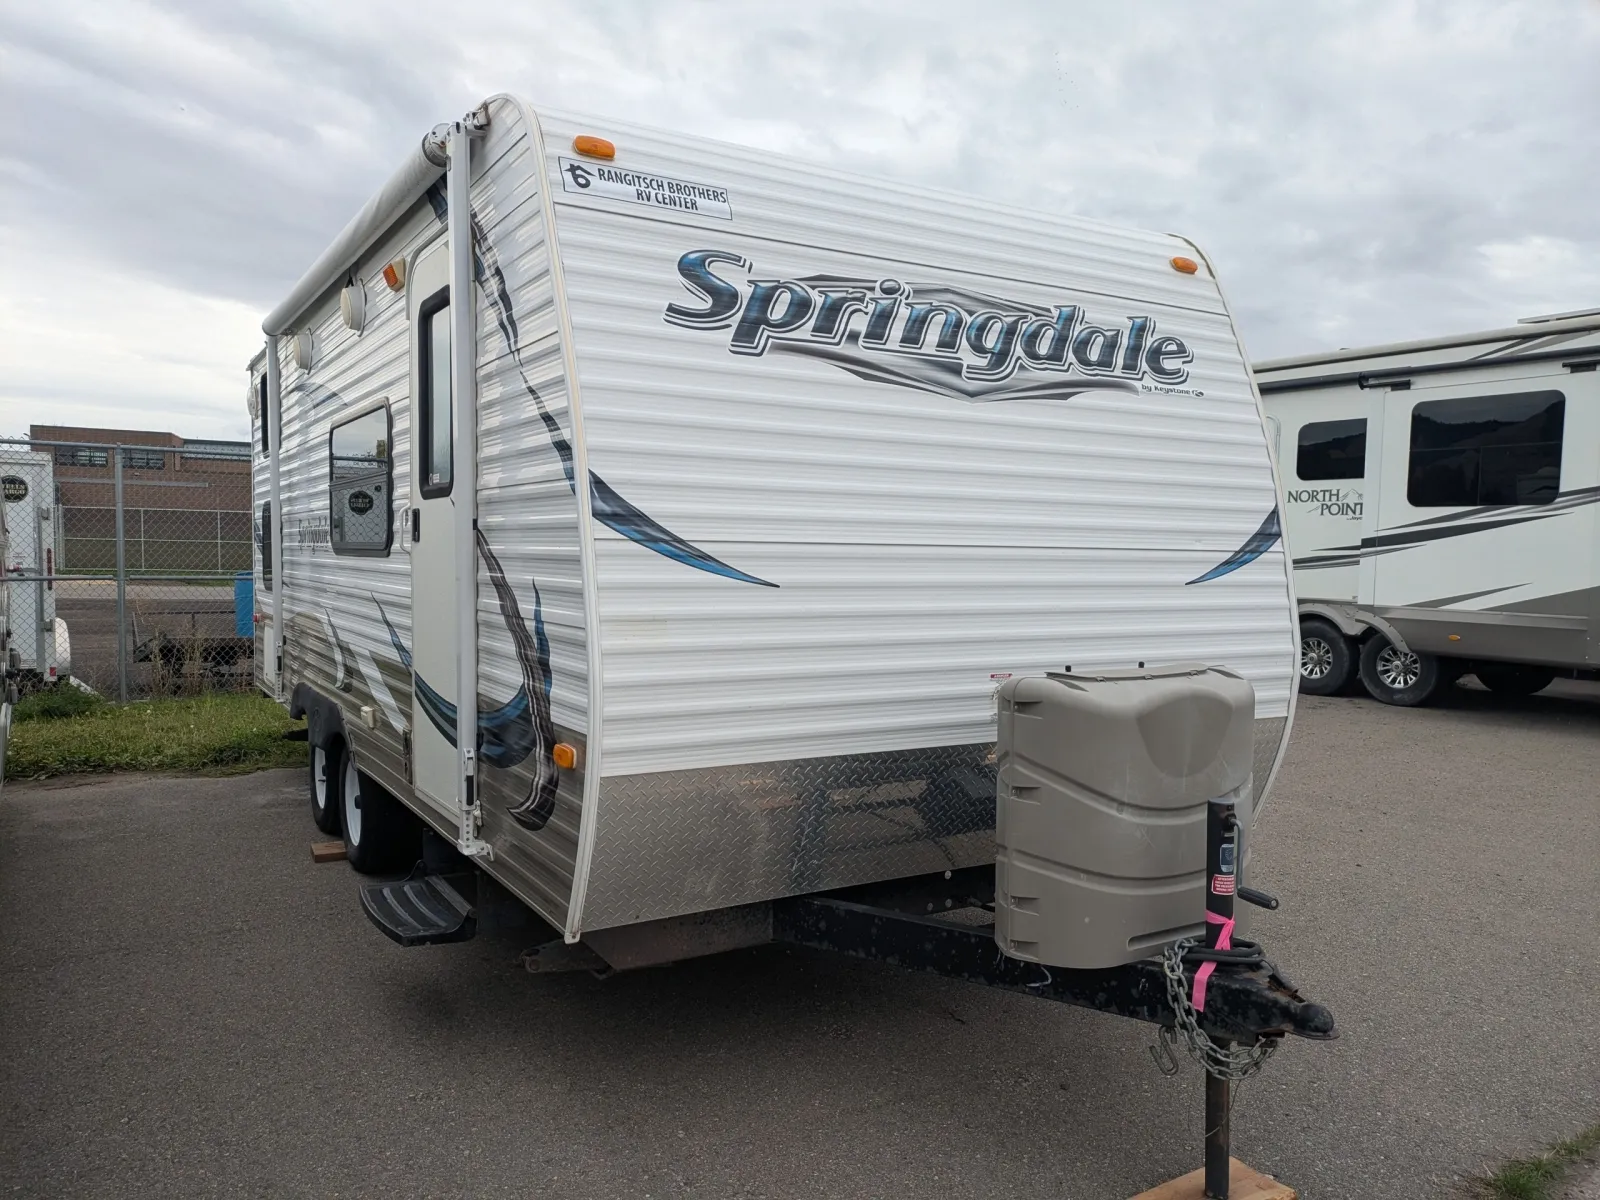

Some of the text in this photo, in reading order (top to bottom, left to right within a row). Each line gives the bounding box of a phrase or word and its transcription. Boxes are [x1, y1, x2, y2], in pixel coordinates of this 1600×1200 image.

[597, 167, 727, 203] RANGITSCH BROTHERS
[636, 188, 699, 211] RV CENTER
[663, 249, 1194, 384] Springdale
[1141, 383, 1191, 395] by Keystone
[1287, 488, 1340, 503] NORTH
